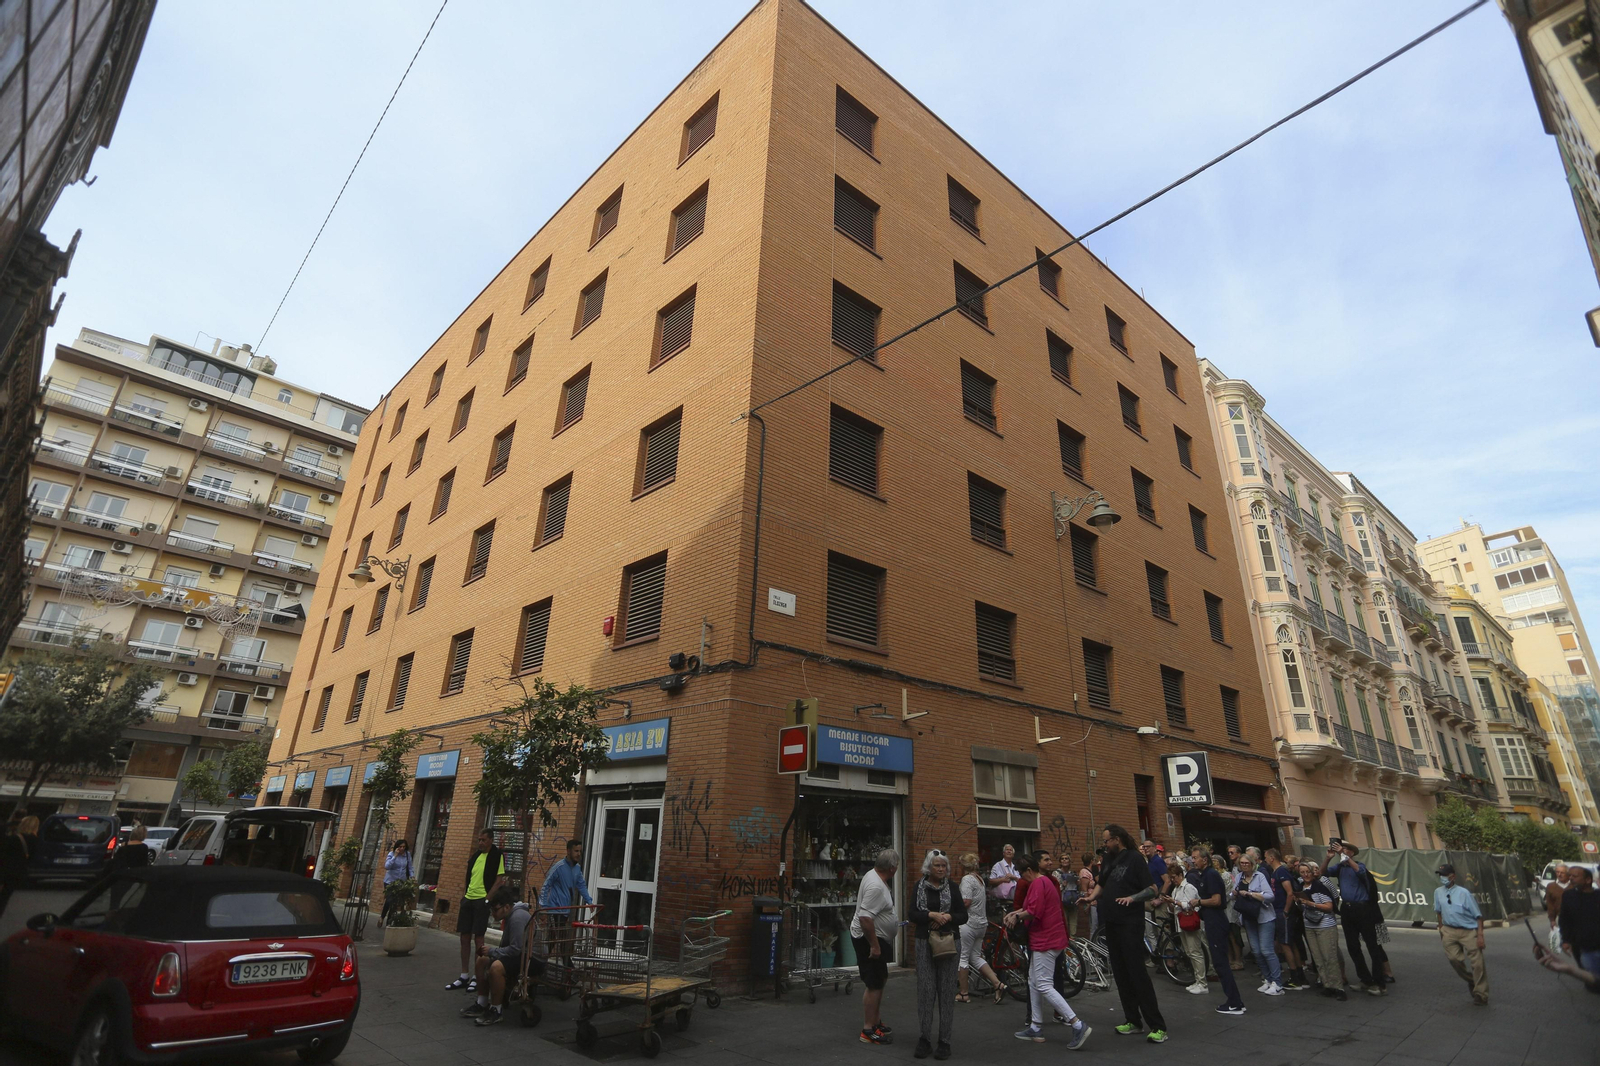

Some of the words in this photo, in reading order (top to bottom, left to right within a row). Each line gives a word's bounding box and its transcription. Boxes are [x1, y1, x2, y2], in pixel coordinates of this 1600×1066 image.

[615, 730, 643, 753] ASIA
[646, 727, 665, 749] ZW
[828, 729, 859, 742] MENAJE
[861, 734, 889, 747] HOGAR
[840, 742, 880, 755] BISUTERIA
[844, 754, 875, 766] MODAS
[1167, 756, 1199, 796] P
[243, 964, 277, 979] 9238
[281, 961, 306, 976] FNK
